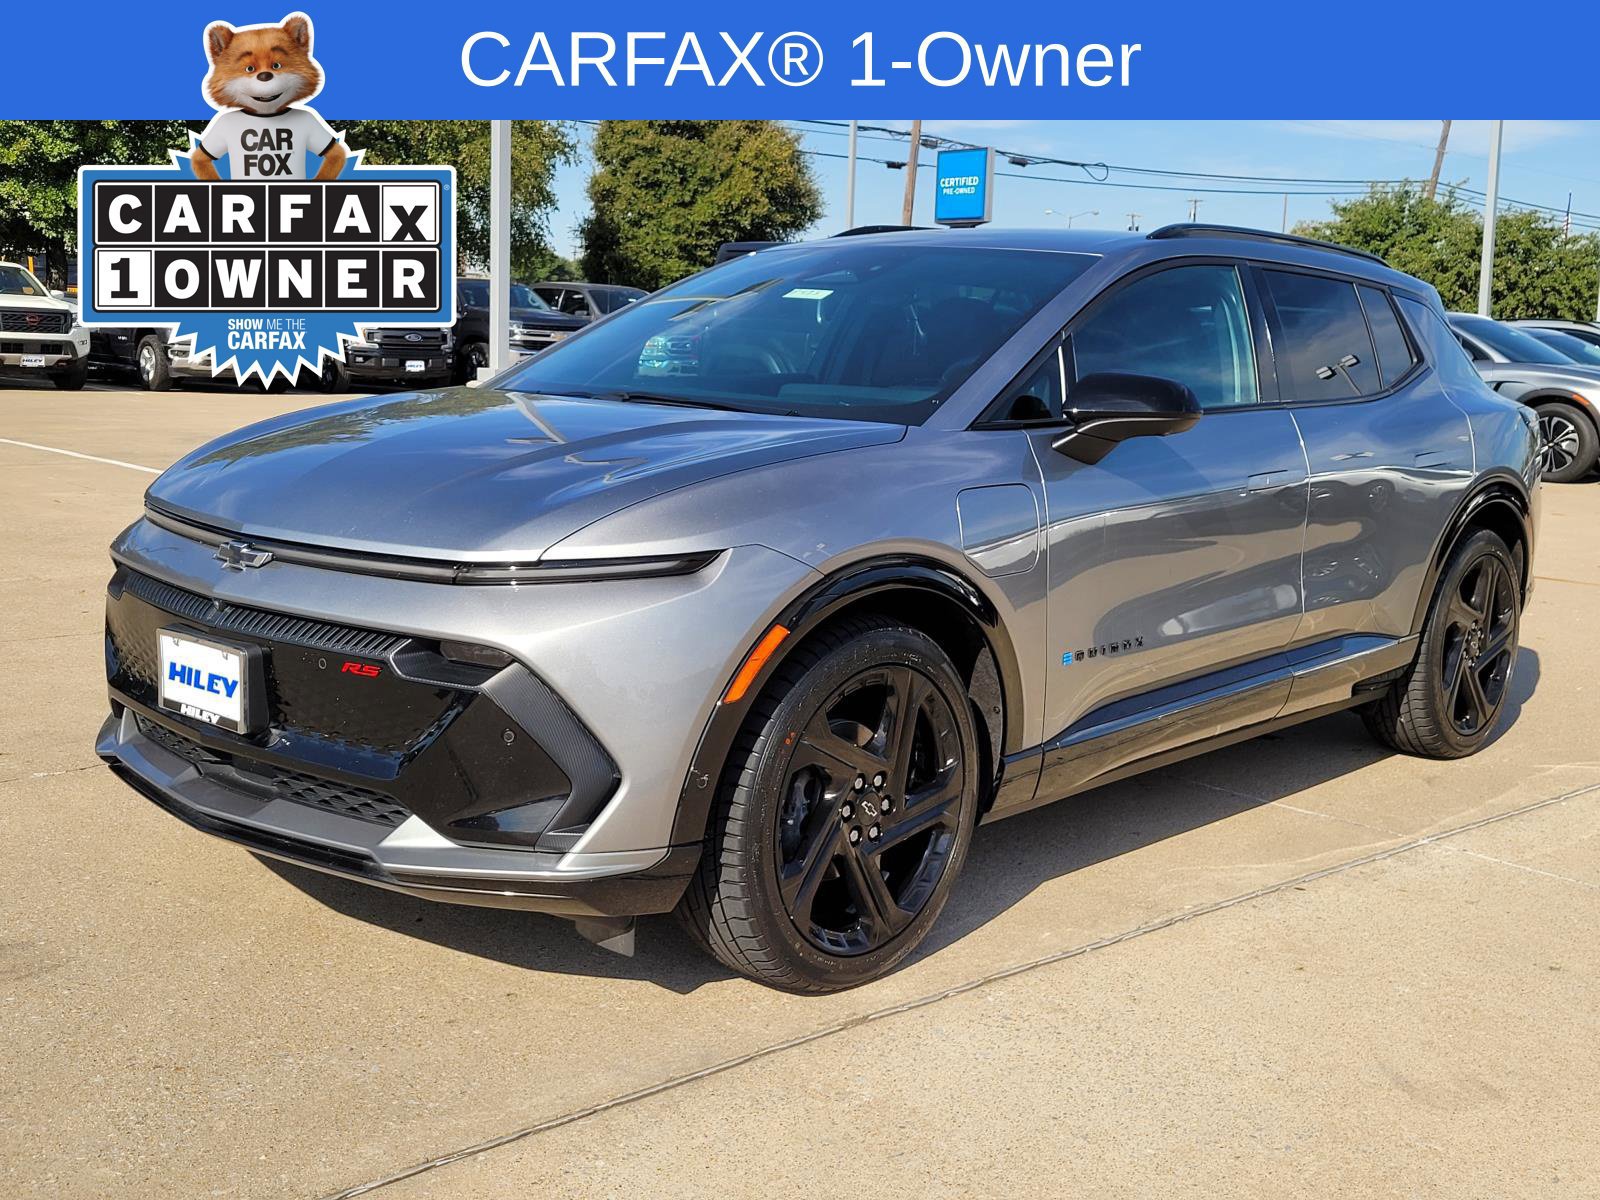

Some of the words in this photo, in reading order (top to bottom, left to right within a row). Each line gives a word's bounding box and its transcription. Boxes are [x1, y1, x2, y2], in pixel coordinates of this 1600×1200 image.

[940, 176, 979, 187] CERTIFIED
[942, 187, 976, 195] PRE-OWNED
[341, 662, 383, 678] RS
[168, 661, 239, 699] HILEY
[180, 704, 219, 724] HILEY
